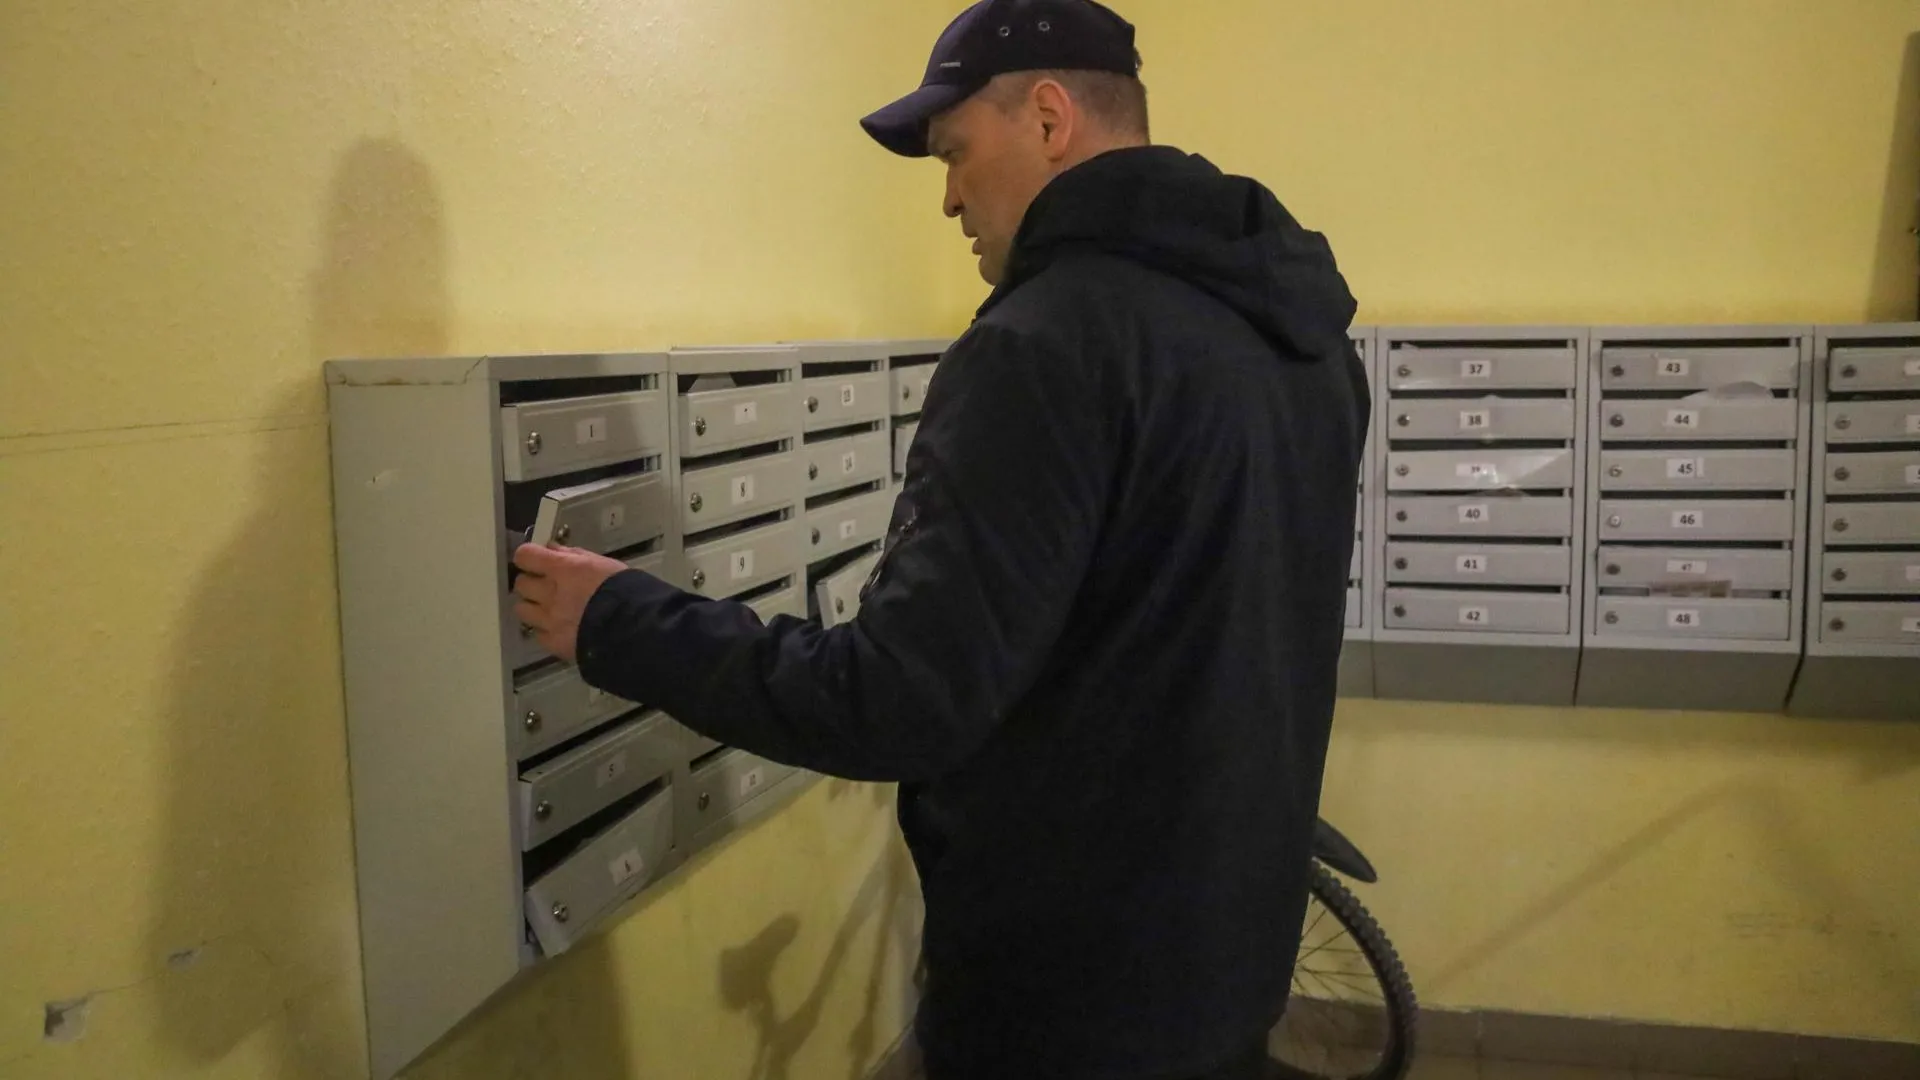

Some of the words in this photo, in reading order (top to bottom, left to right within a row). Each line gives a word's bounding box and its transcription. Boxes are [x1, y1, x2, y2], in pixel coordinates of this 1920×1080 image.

[1469, 364, 1483, 374] 37
[1665, 363, 1681, 373] 43
[1468, 415, 1482, 426] 38
[1674, 414, 1690, 424] 44
[1677, 463, 1693, 474] 45
[1465, 508, 1481, 519] 40
[1680, 514, 1695, 525] 46
[739, 556, 745, 572] 9
[1463, 559, 1478, 569] 41
[1466, 611, 1481, 621] 42
[1675, 613, 1691, 624] 48
